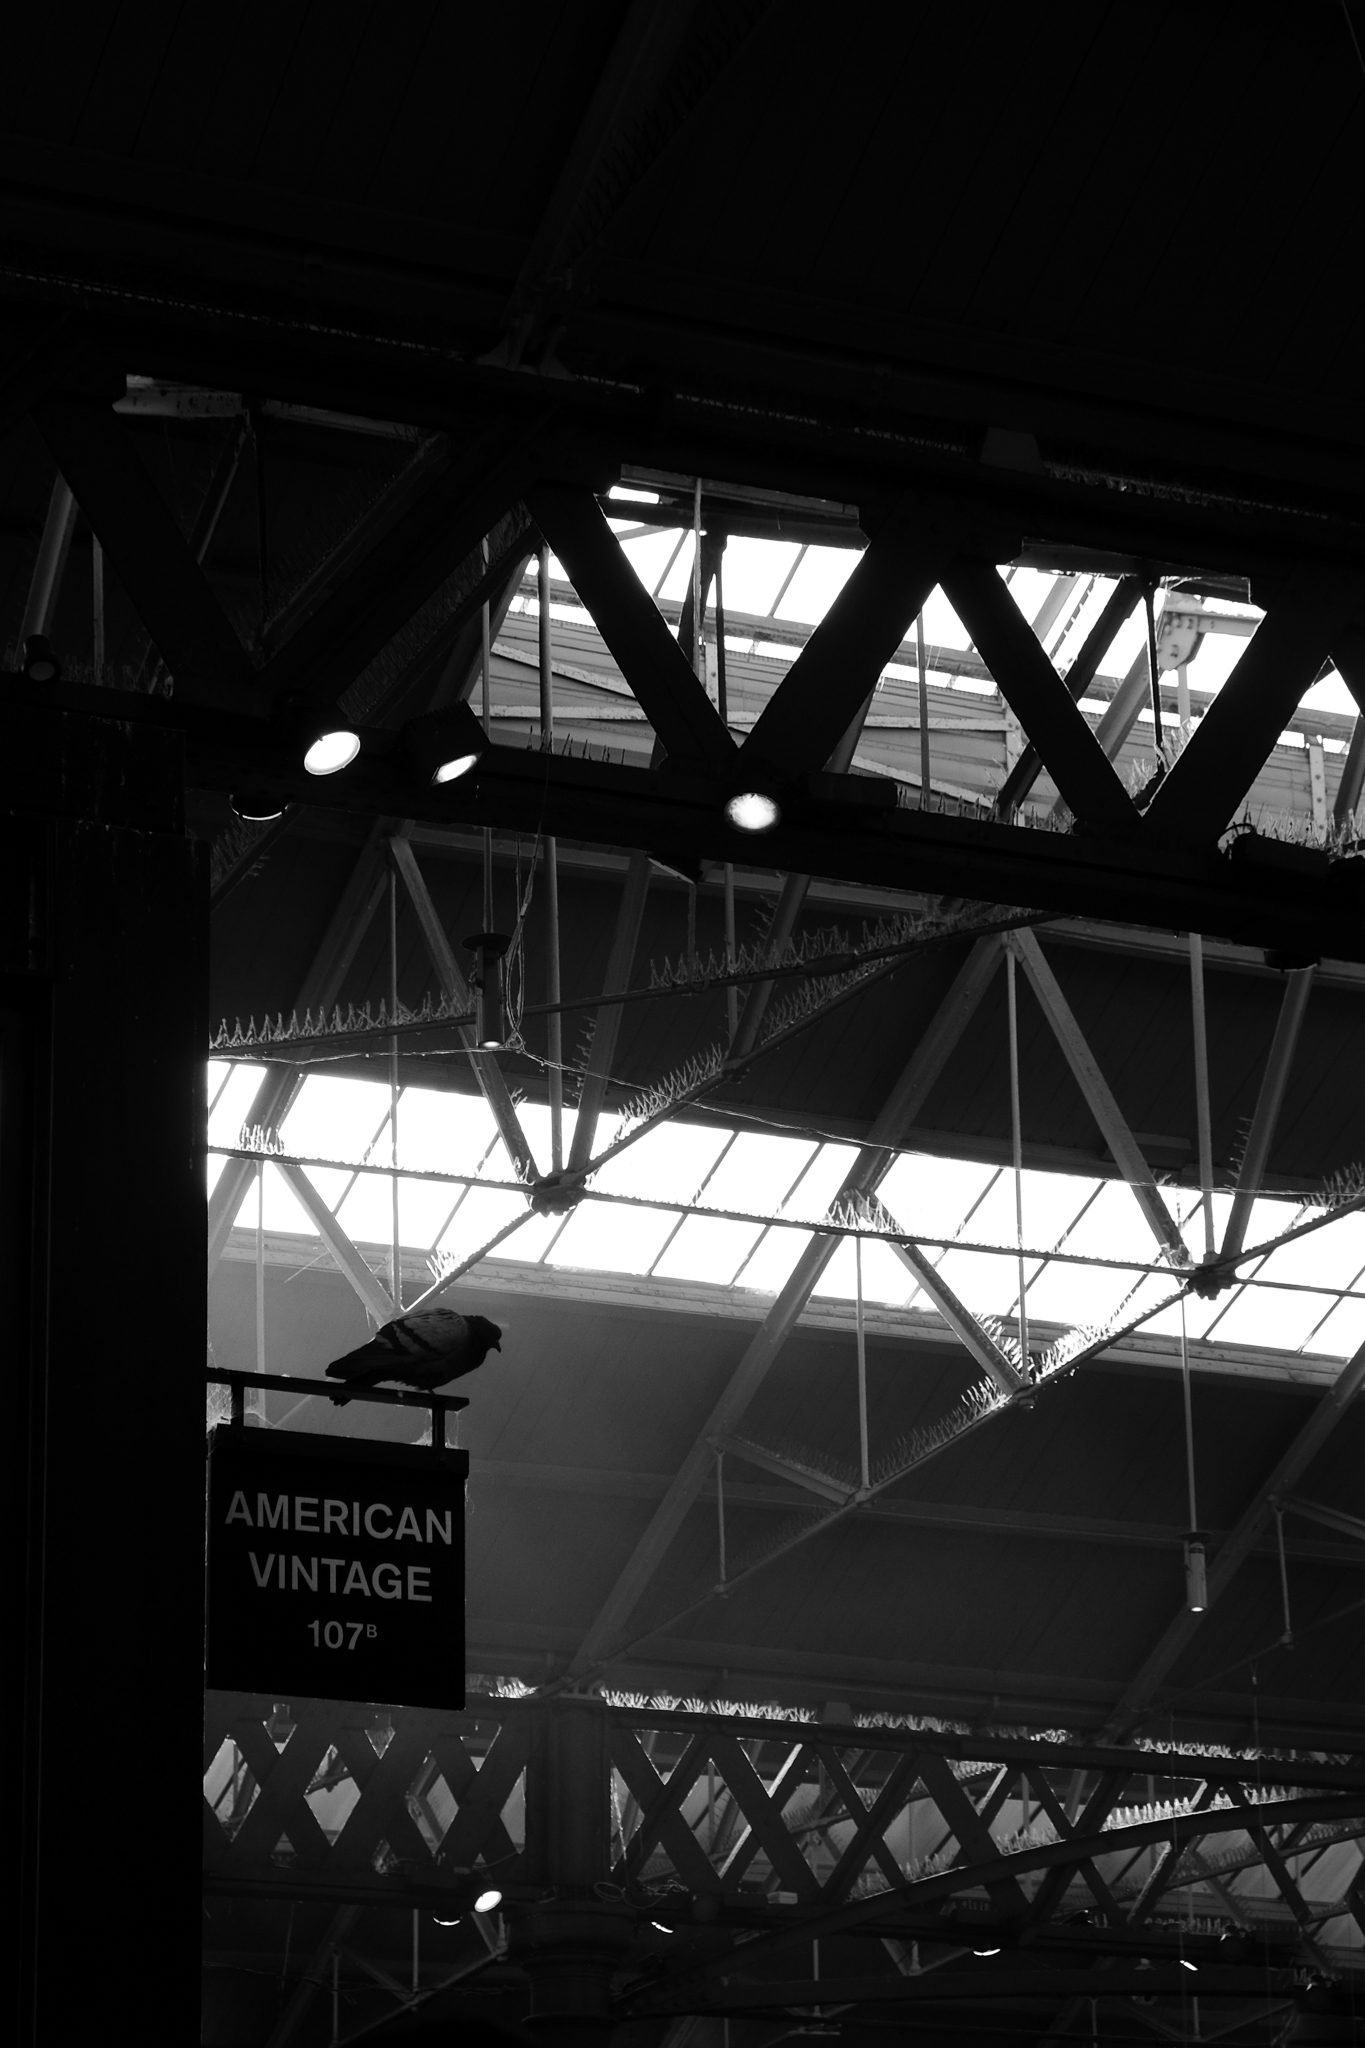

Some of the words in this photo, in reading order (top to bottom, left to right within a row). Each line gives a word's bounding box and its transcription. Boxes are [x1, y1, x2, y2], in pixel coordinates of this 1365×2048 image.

[224, 1490, 452, 1545] AMERICAN
[248, 1552, 432, 1602] VINTAGE
[307, 1620, 377, 1650] 107B
